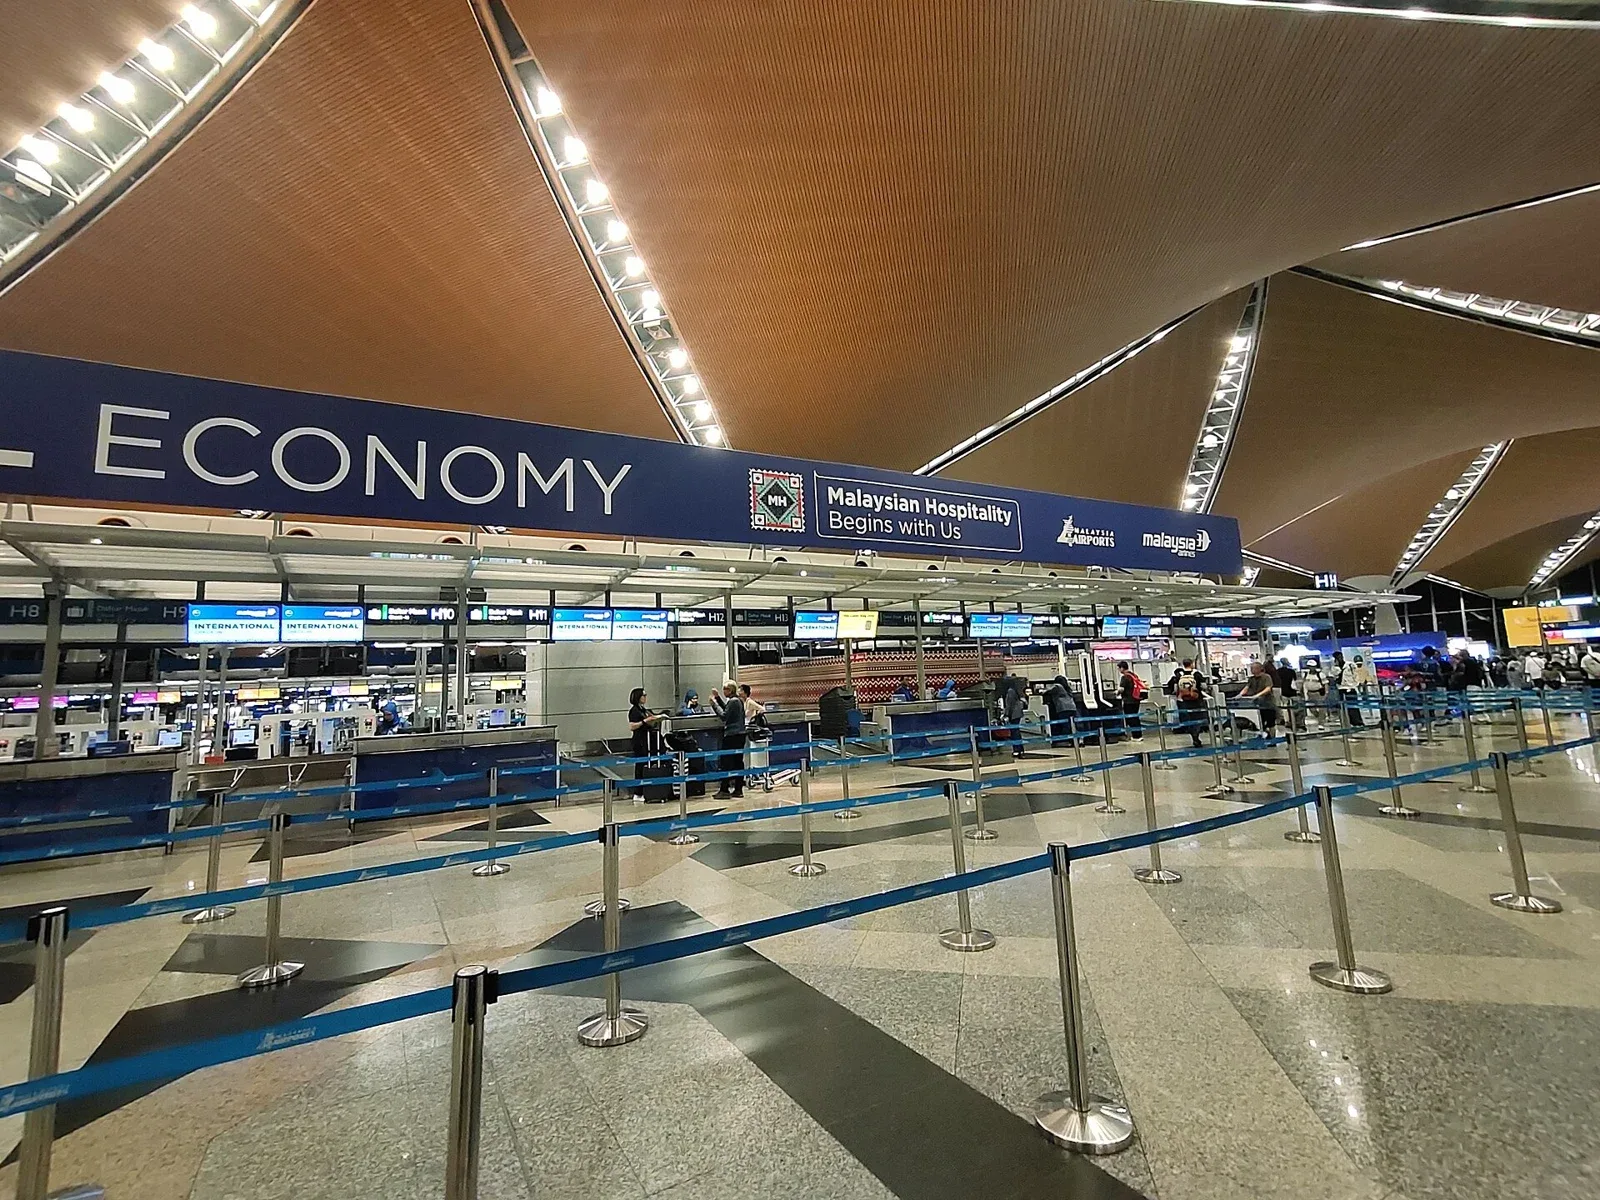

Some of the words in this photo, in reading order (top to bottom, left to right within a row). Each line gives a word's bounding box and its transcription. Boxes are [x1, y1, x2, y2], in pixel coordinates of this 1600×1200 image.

[94, 403, 632, 516] ECONOMY
[768, 495, 788, 507] MH
[827, 486, 920, 513] Malaysian
[925, 498, 1012, 526] Hospitality
[829, 510, 893, 535] Begins
[898, 518, 936, 537] with
[940, 522, 962, 540] Us
[1074, 527, 1115, 537] MALAYSIA
[1073, 536, 1115, 548] AIRPORTS
[1143, 531, 1196, 553] malaysia
[9, 604, 40, 618] H8
[163, 606, 187, 618] H9
[430, 607, 455, 620] H10
[528, 608, 548, 621] H11
[708, 612, 725, 622] H12
[774, 613, 789, 622] H13
